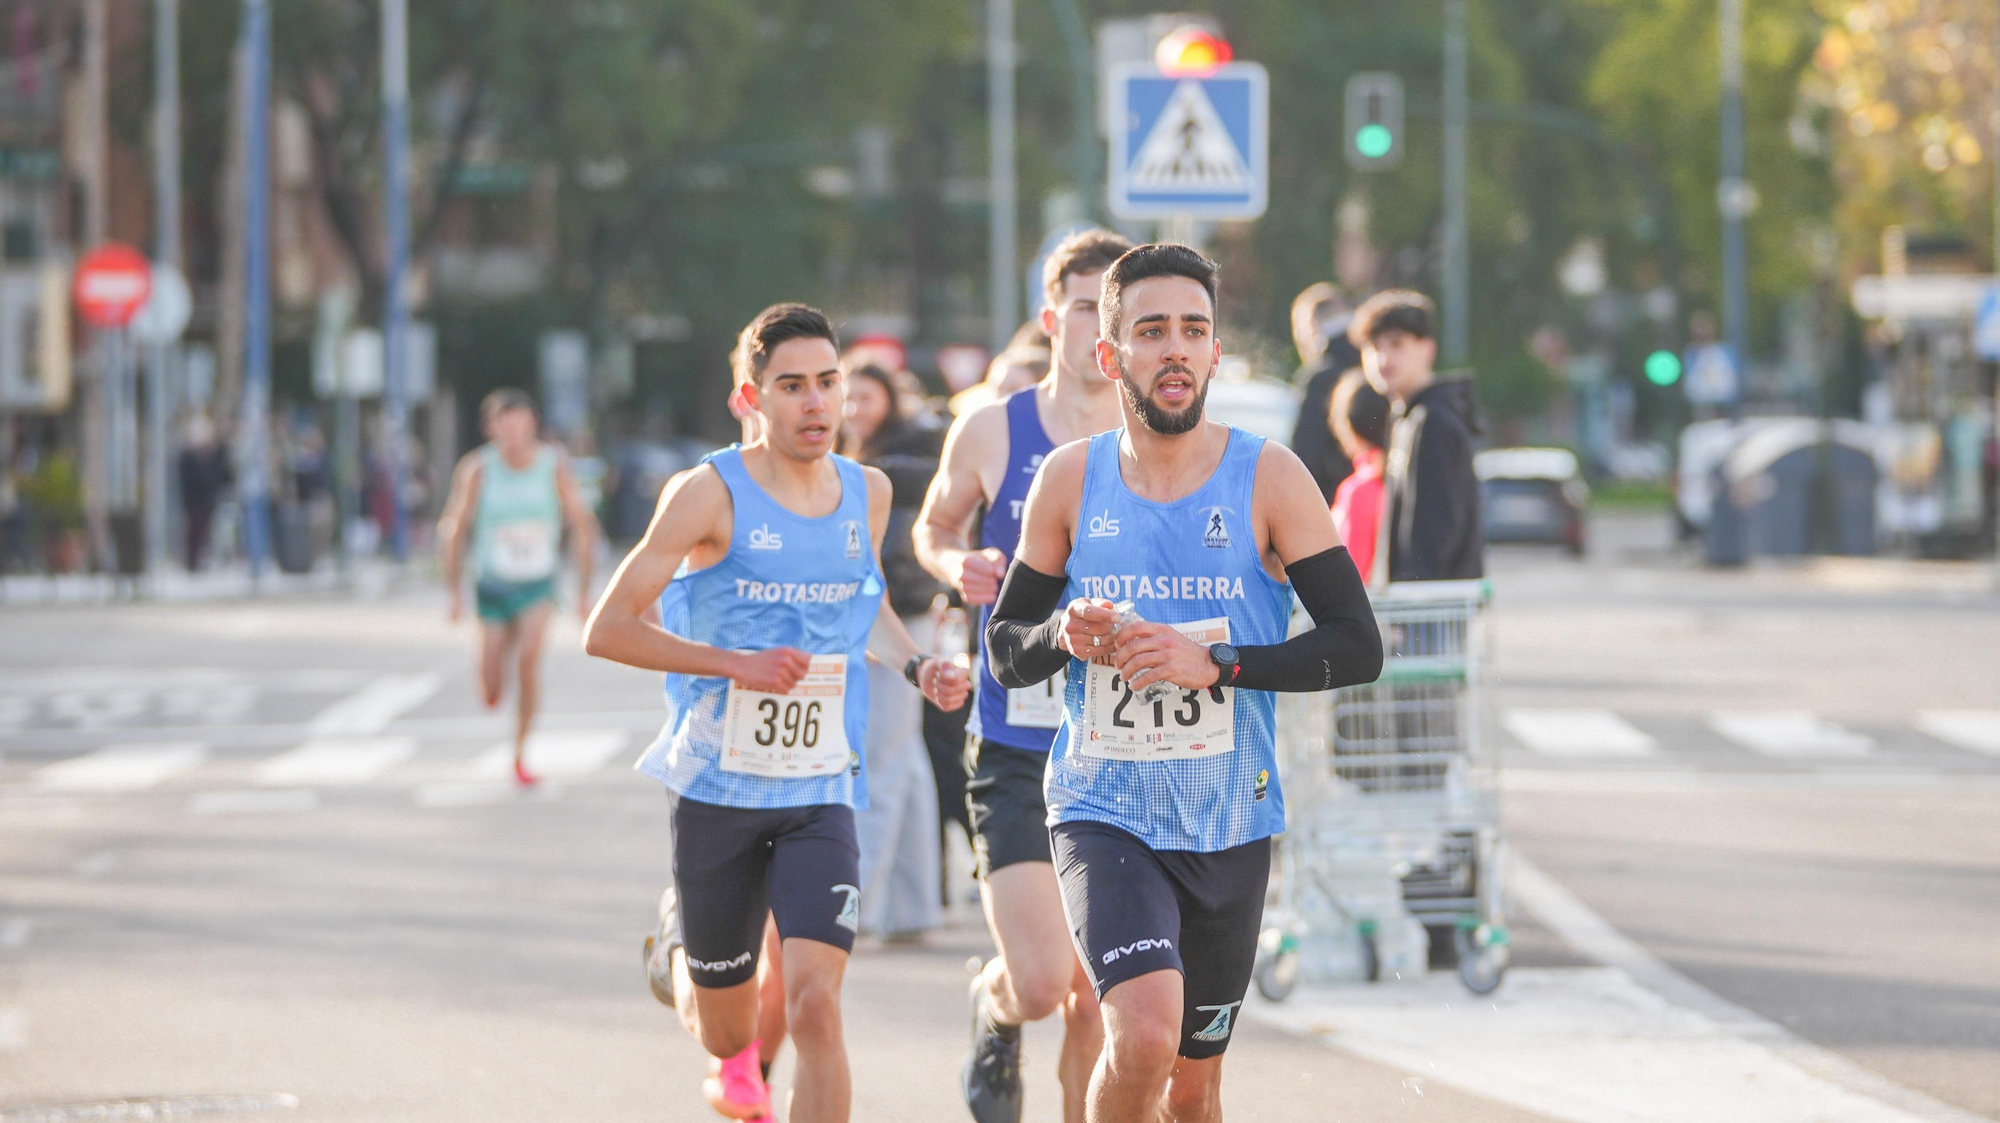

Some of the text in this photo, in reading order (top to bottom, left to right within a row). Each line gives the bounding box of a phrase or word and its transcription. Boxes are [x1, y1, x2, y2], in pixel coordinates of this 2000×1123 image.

[1081, 574, 1246, 600] TROTASIERRA
[754, 697, 822, 748] 396
[1102, 938, 1173, 965] GIVOVA
